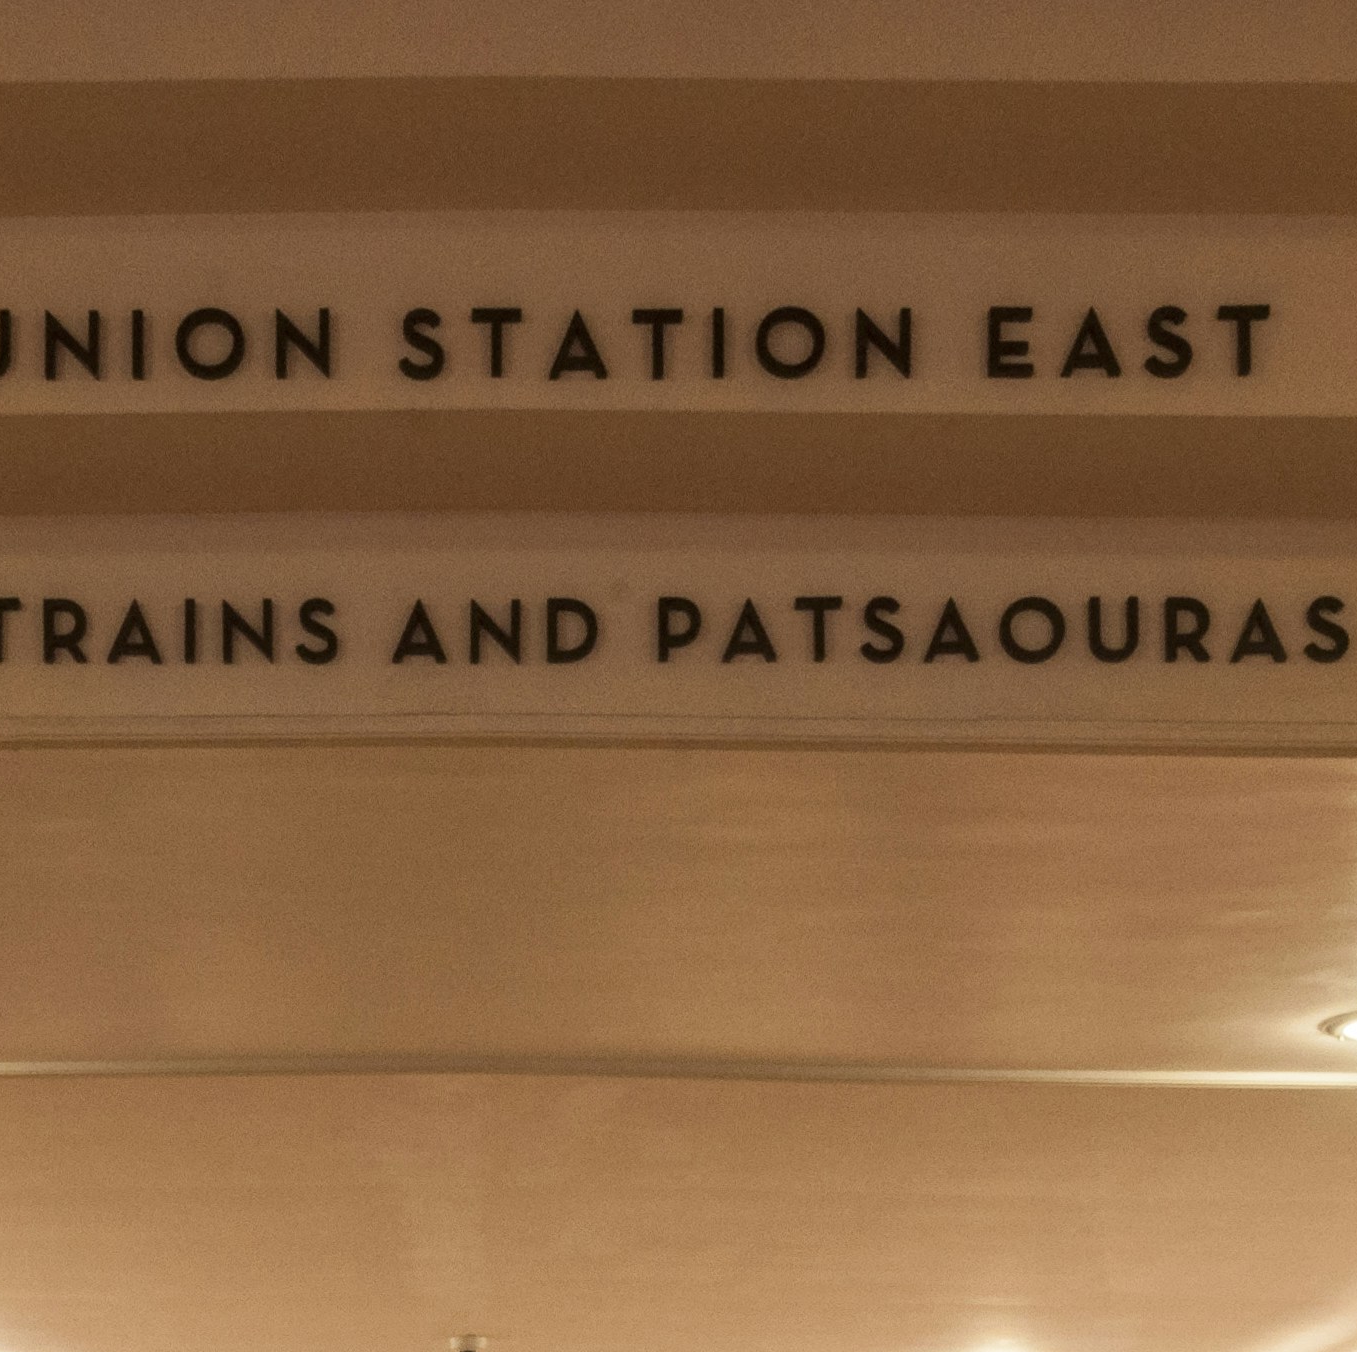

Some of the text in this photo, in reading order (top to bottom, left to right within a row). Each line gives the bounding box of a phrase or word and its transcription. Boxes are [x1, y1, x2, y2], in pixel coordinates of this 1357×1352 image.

[397, 305, 916, 382] STATION
[982, 303, 1272, 380] EAST
[391, 596, 601, 666] AND
[655, 595, 1351, 665] PATSAOURAS
